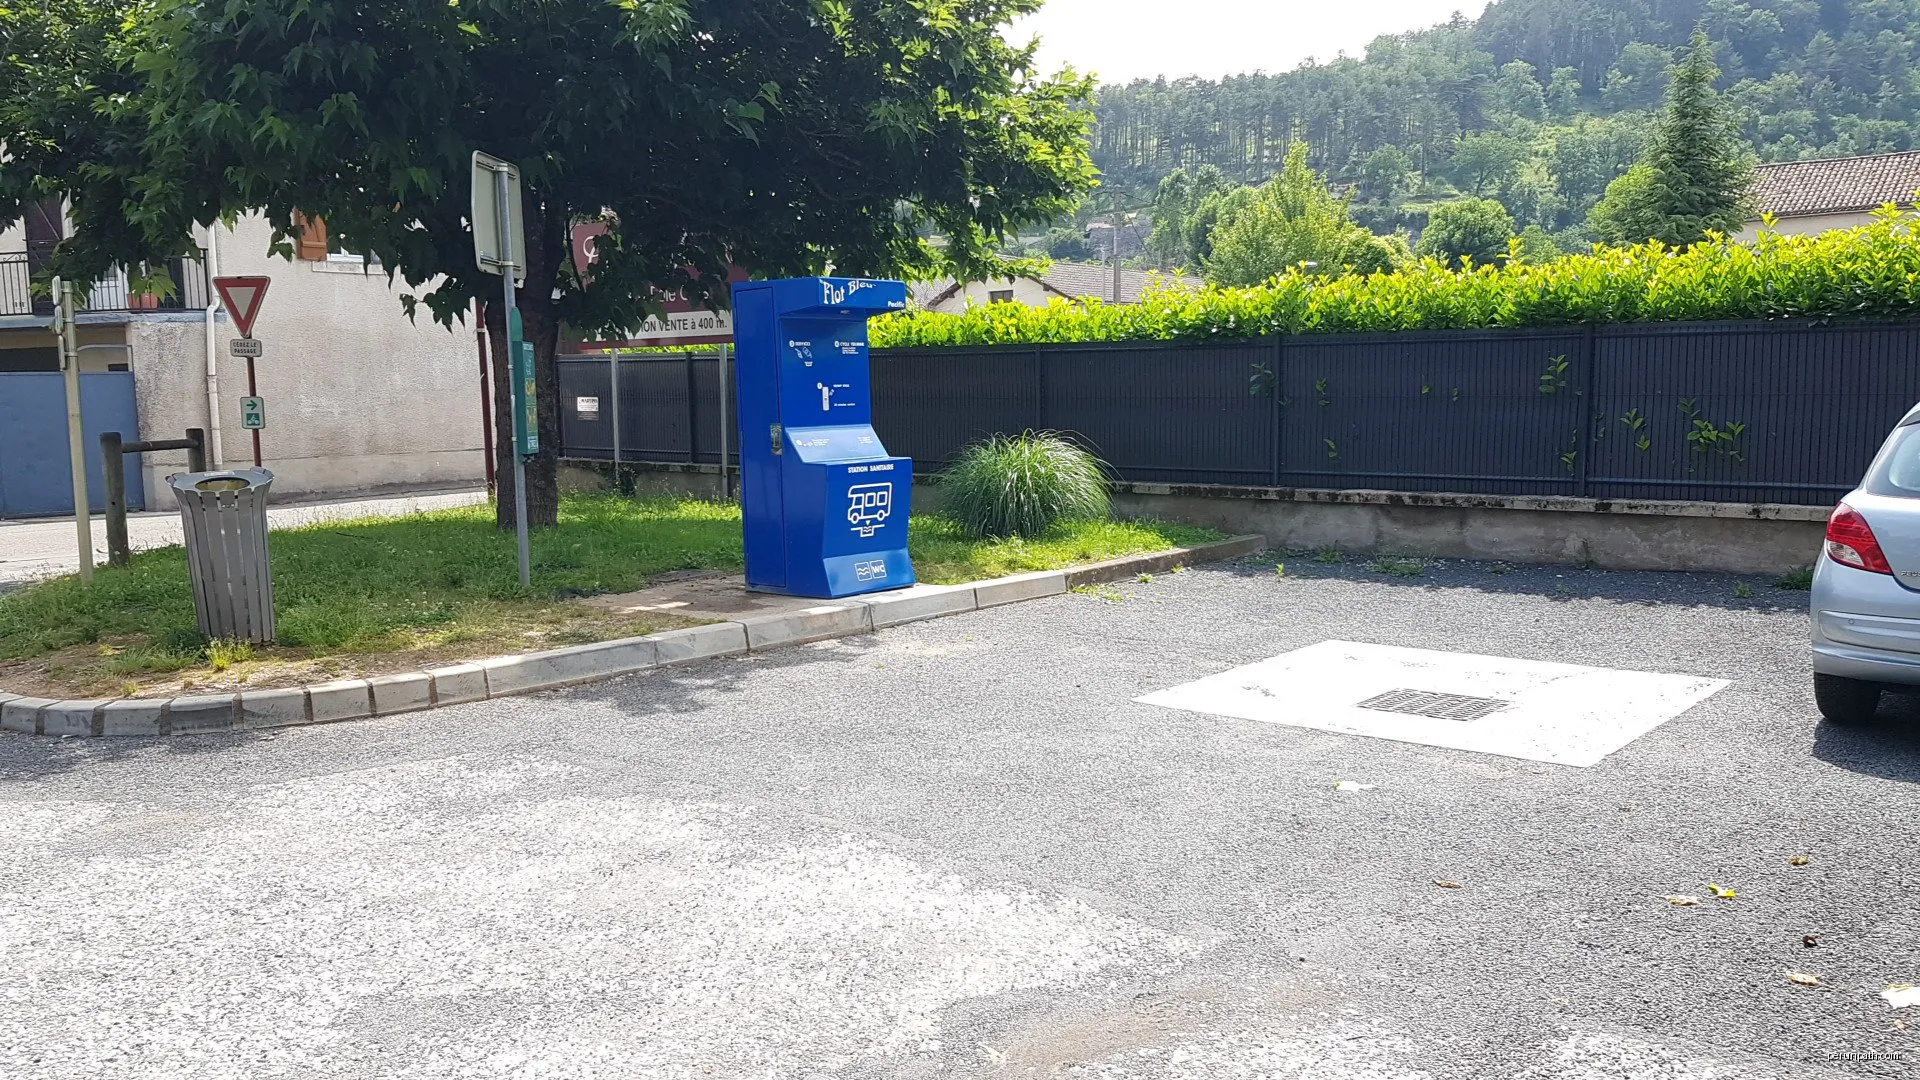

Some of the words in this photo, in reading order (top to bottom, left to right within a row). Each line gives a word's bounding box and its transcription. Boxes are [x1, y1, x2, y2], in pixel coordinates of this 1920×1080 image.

[698, 317, 714, 329] 400
[870, 464, 894, 472] SANITAIRE
[872, 565, 886, 573] WC
